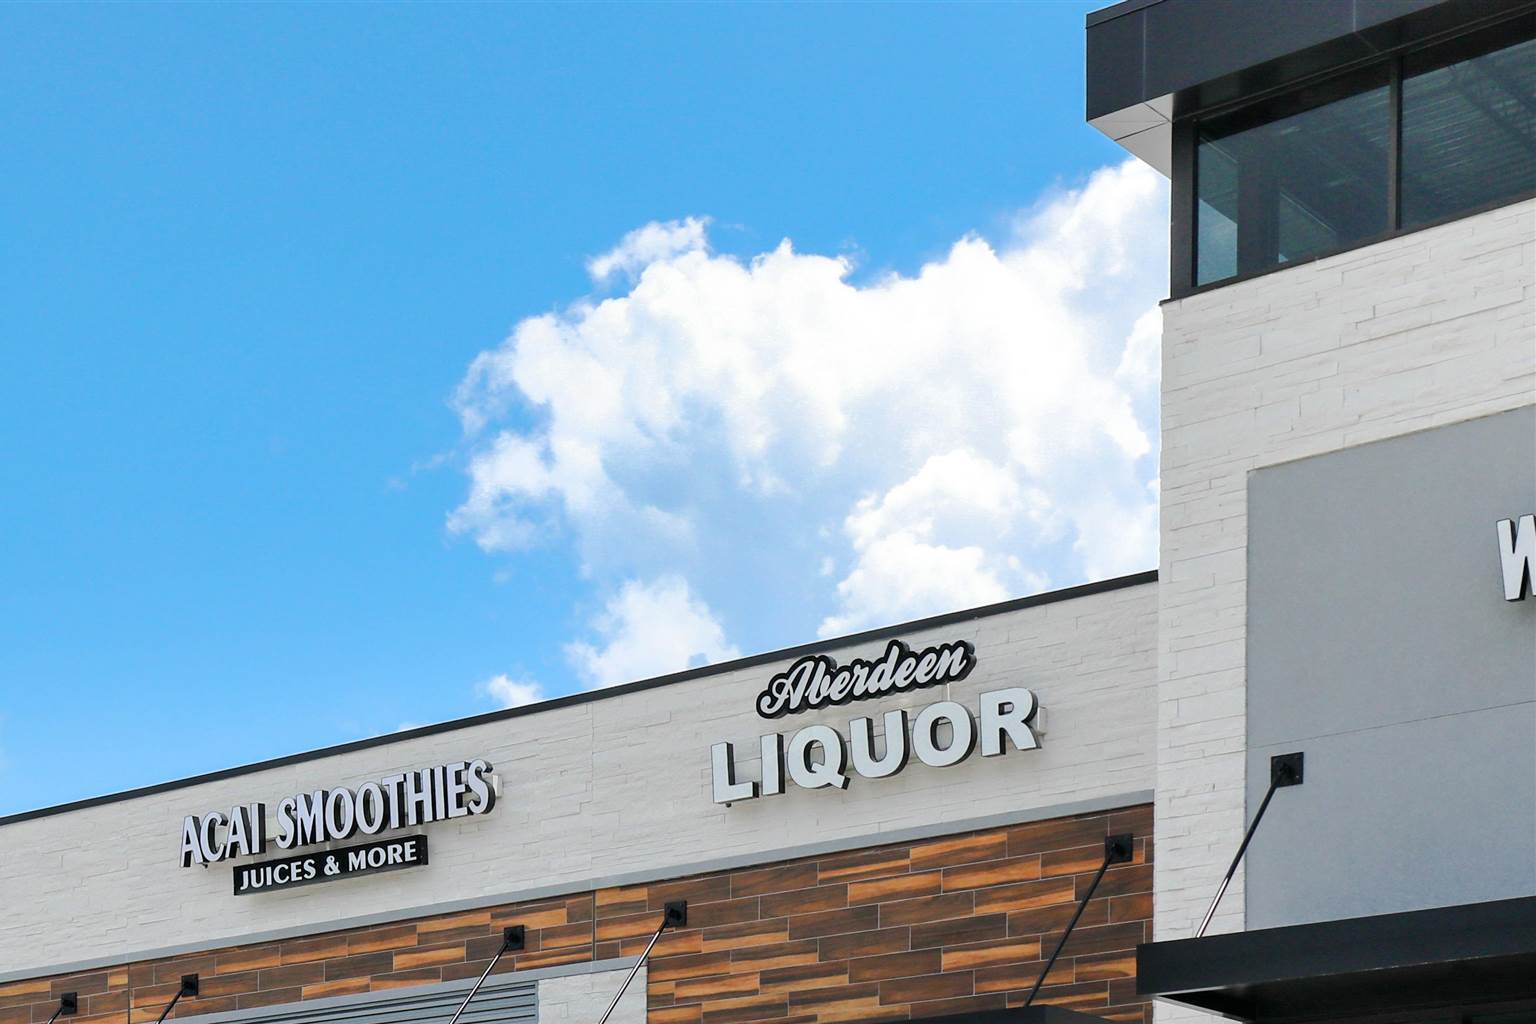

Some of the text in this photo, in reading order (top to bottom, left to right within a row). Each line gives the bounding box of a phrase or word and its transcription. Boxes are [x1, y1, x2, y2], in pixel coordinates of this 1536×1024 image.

[760, 644, 967, 714] Aberdeen
[711, 687, 1038, 804] LIQUOR
[180, 759, 493, 868] ACAI SMOOTHIES
[240, 840, 417, 890] JUICES & MORE
